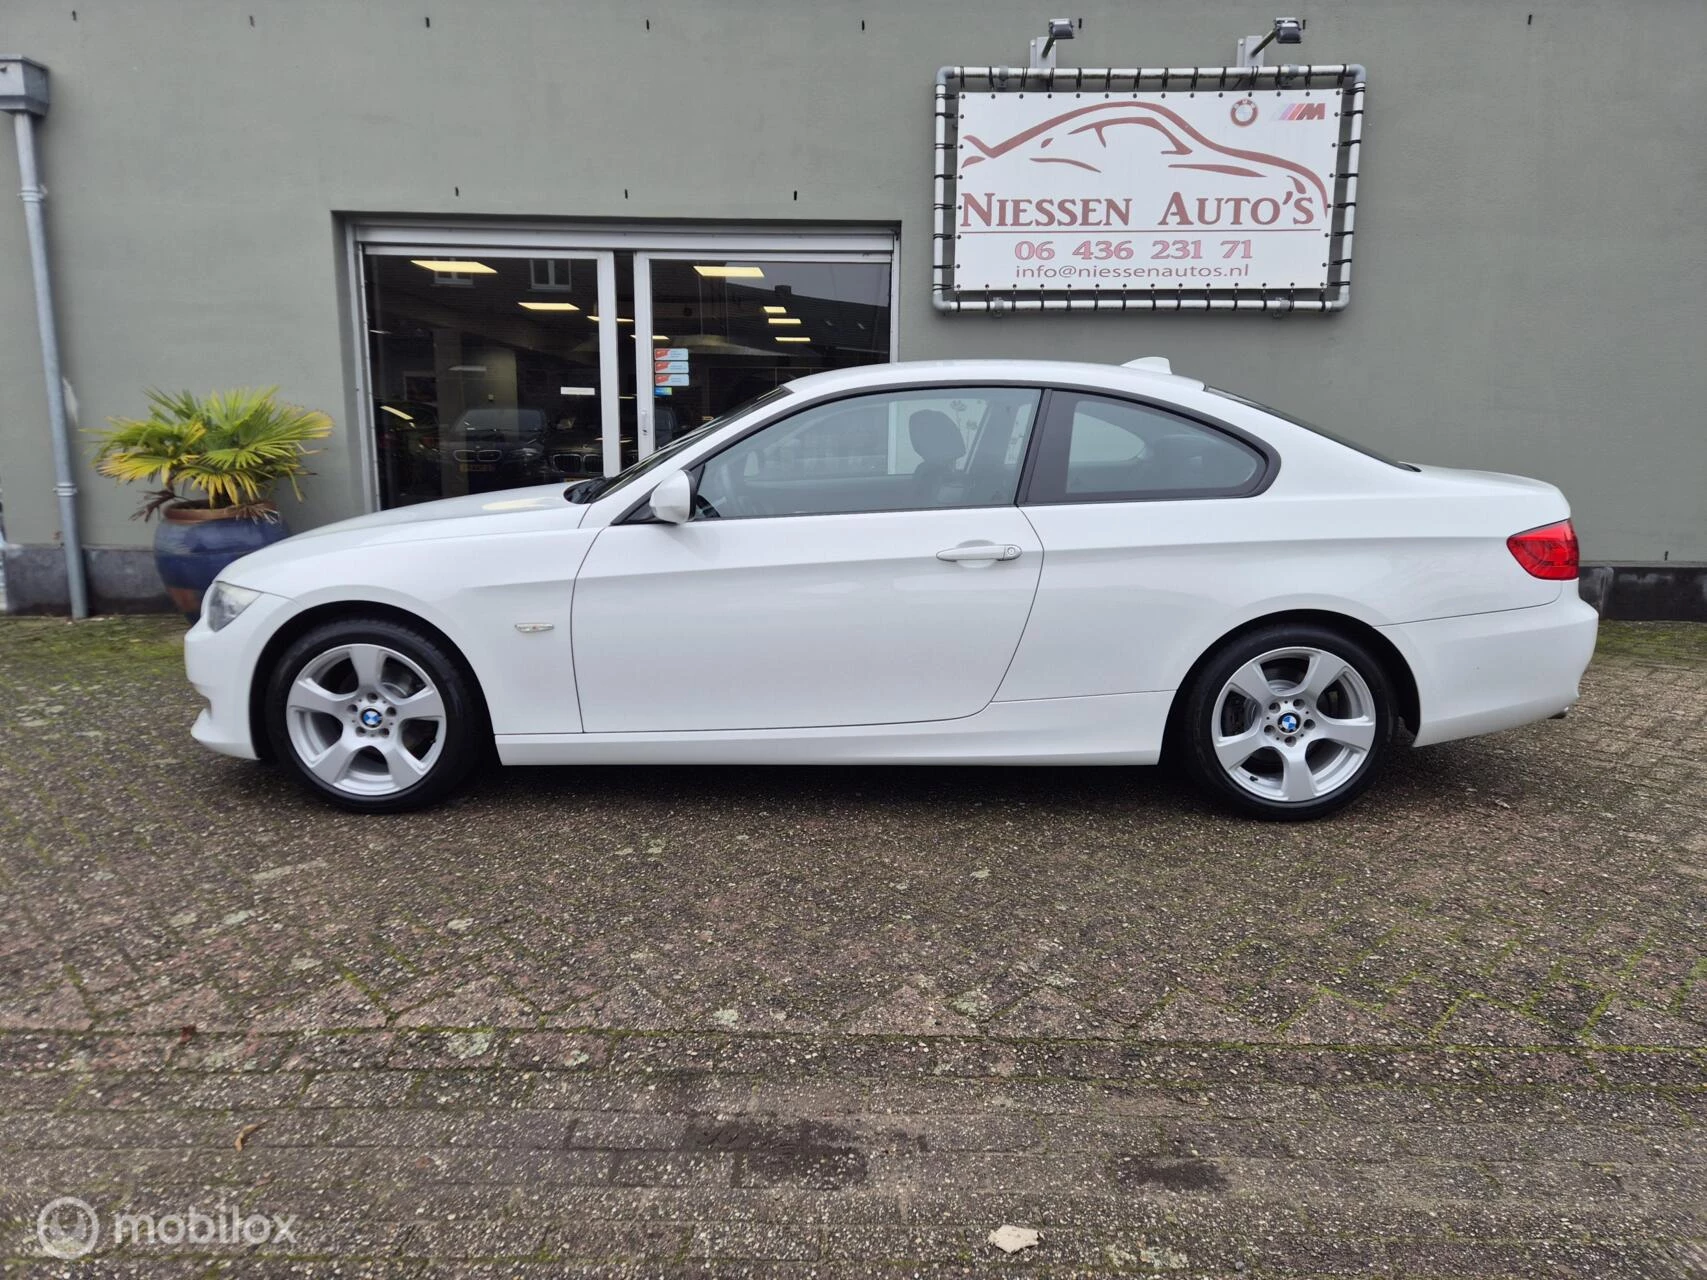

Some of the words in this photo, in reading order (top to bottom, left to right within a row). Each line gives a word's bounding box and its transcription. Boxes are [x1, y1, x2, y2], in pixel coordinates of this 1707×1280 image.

[961, 193, 1132, 226] NIESSEN
[1158, 192, 1314, 225] AUTO'S
[1015, 240, 1055, 260] 06
[1073, 241, 1134, 260] 436
[1151, 240, 1202, 259] 231
[1220, 240, 1253, 259] 71
[1016, 264, 1249, 278] info@niessenautos.nl
